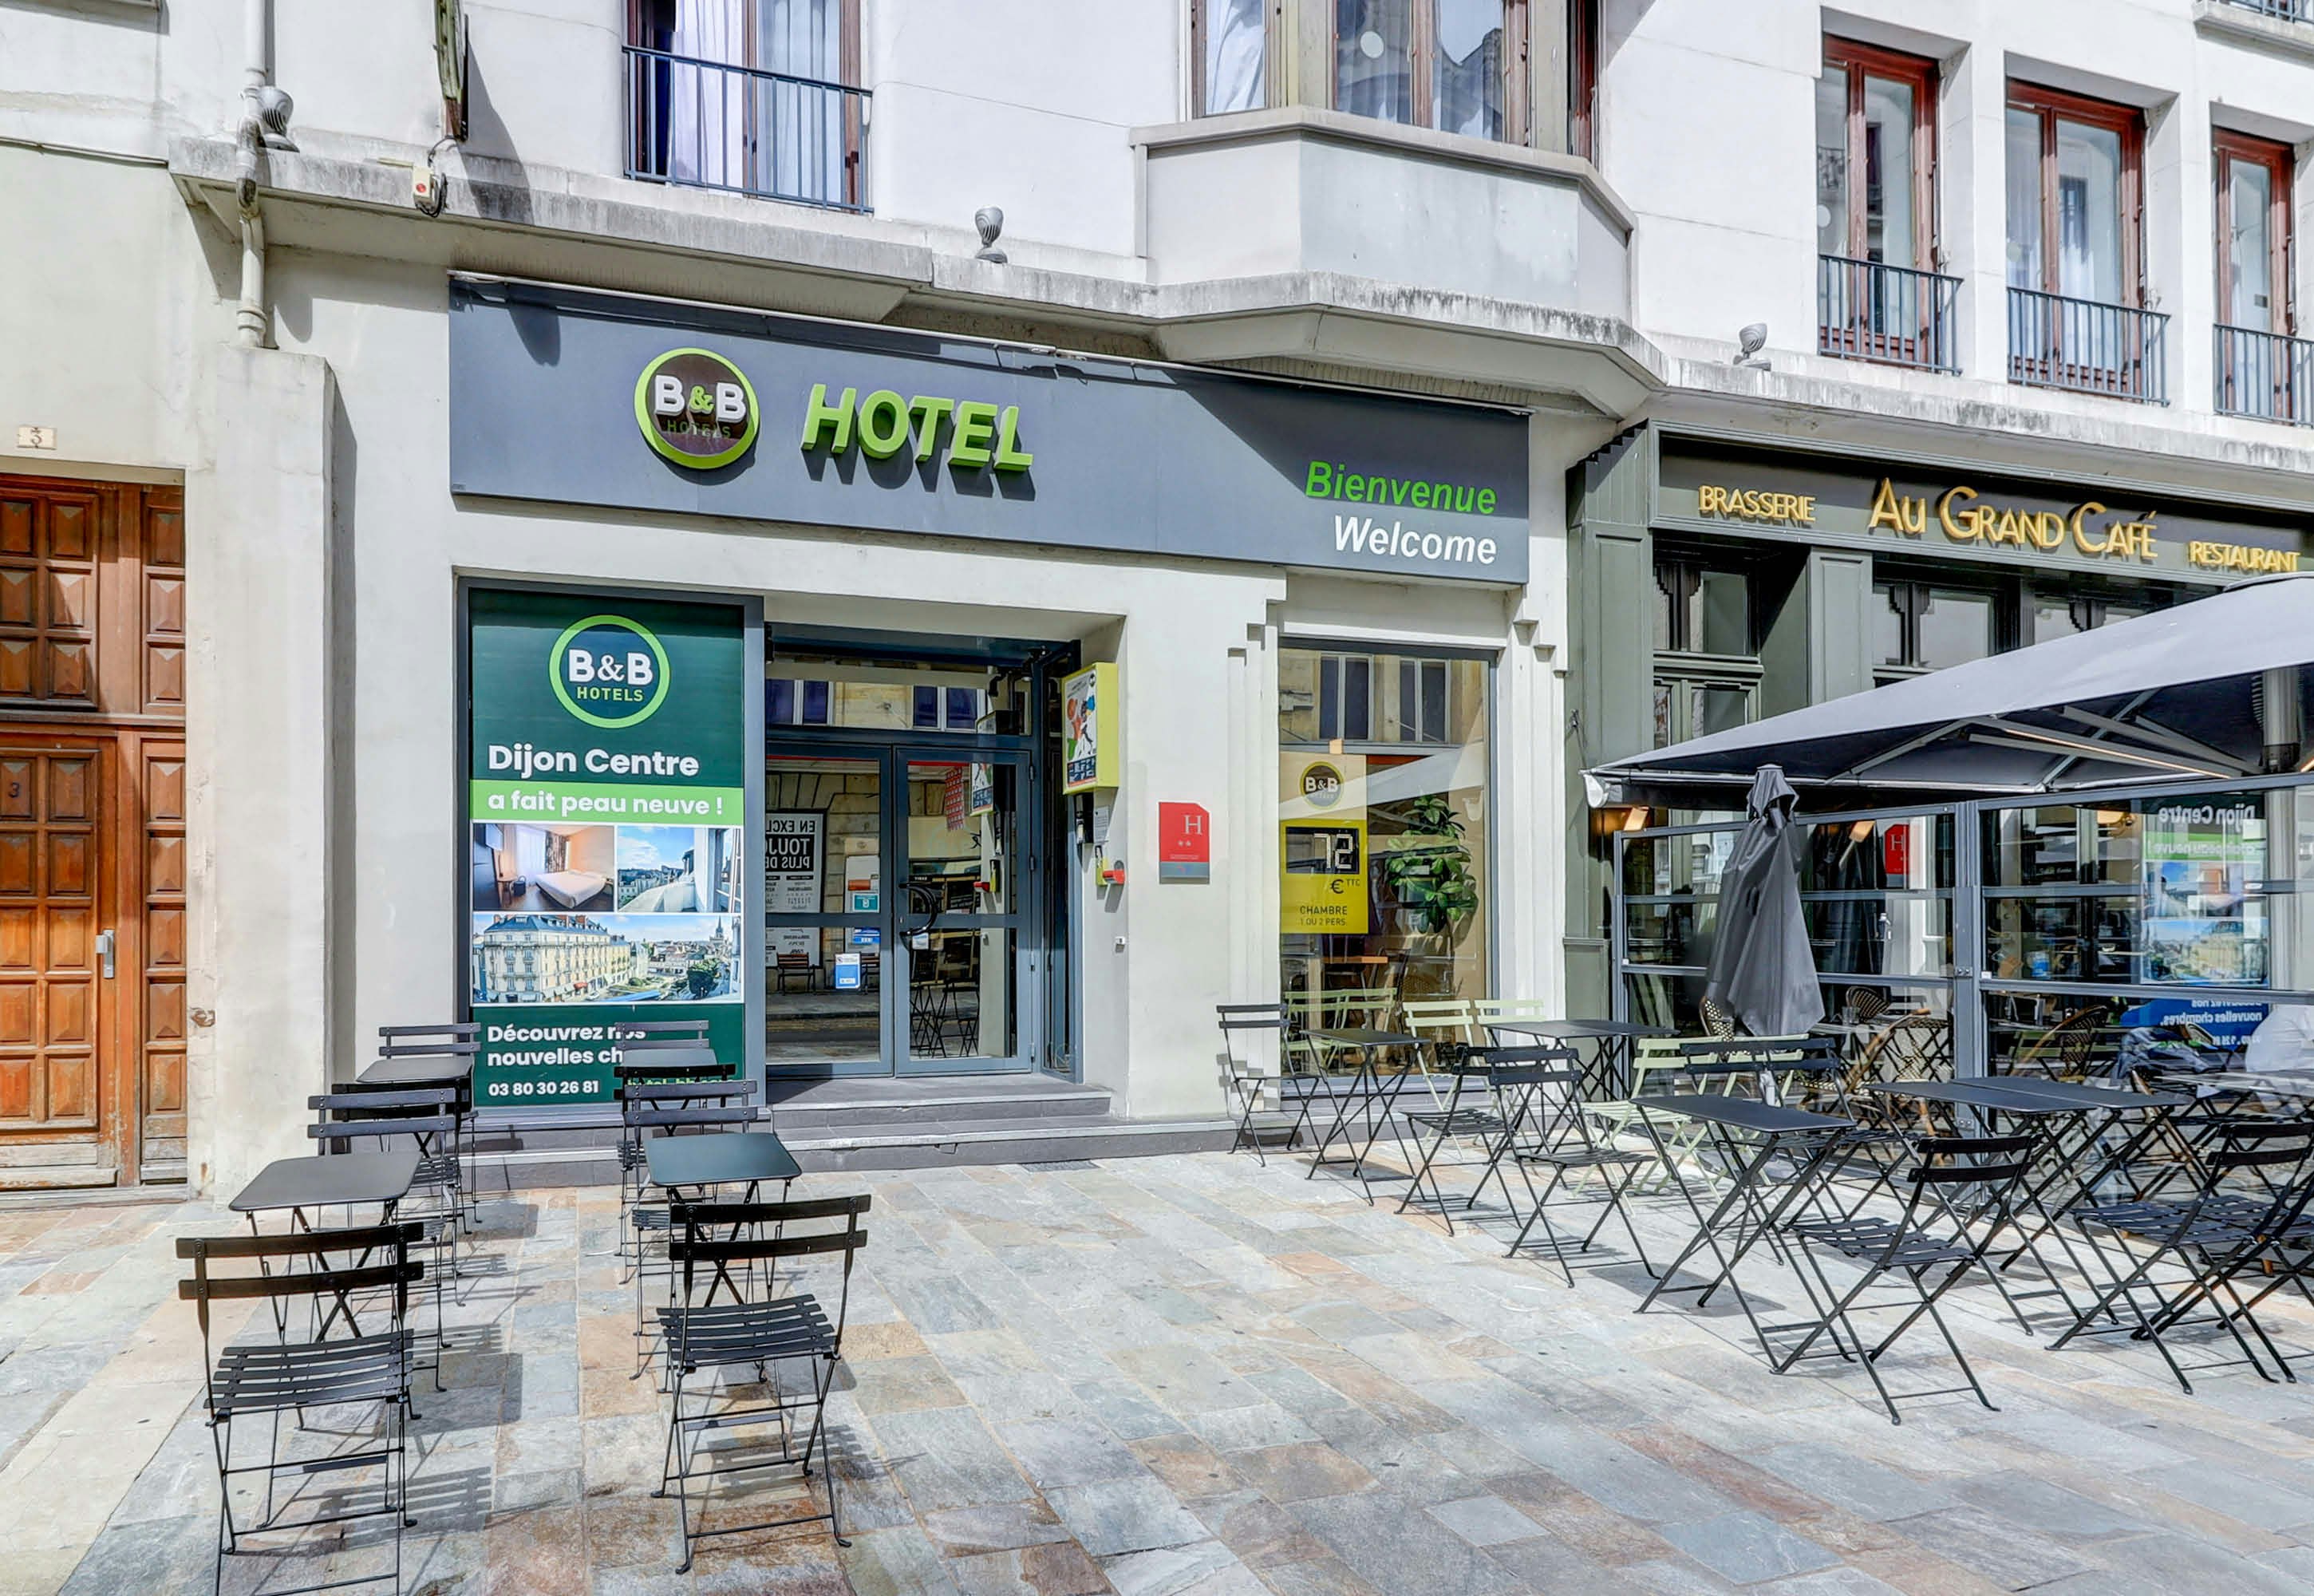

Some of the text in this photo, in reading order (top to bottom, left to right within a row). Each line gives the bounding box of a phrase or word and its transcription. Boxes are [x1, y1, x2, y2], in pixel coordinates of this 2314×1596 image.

[654, 374, 747, 423] B&B
[800, 383, 1033, 472] HOTEL
[1305, 460, 1497, 514] Bienvenue
[1699, 485, 1815, 522] BRASSERIE
[1940, 486, 2065, 548] GRAND
[2072, 501, 2158, 558] CAFÉ
[1333, 515, 1497, 564] Welcome
[2189, 539, 2301, 572] RESTAURANT
[567, 649, 654, 686] B&B
[576, 686, 645, 703] HOTELS
[488, 743, 700, 779] Dijon Centre
[8, 782, 20, 798] 3
[1305, 776, 1338, 792] B&B
[488, 792, 505, 810] a
[510, 790, 556, 811] fait
[561, 796, 627, 817] peau
[633, 796, 710, 816] neuve
[1184, 815, 1203, 836] H
[1330, 879, 1360, 894] € TTC
[1299, 905, 1348, 915] CHAMBRE
[487, 1023, 603, 1042] Découvrez
[487, 1047, 594, 1066] nouvelles
[488, 1080, 599, 1096] 03 80 30 26 81
